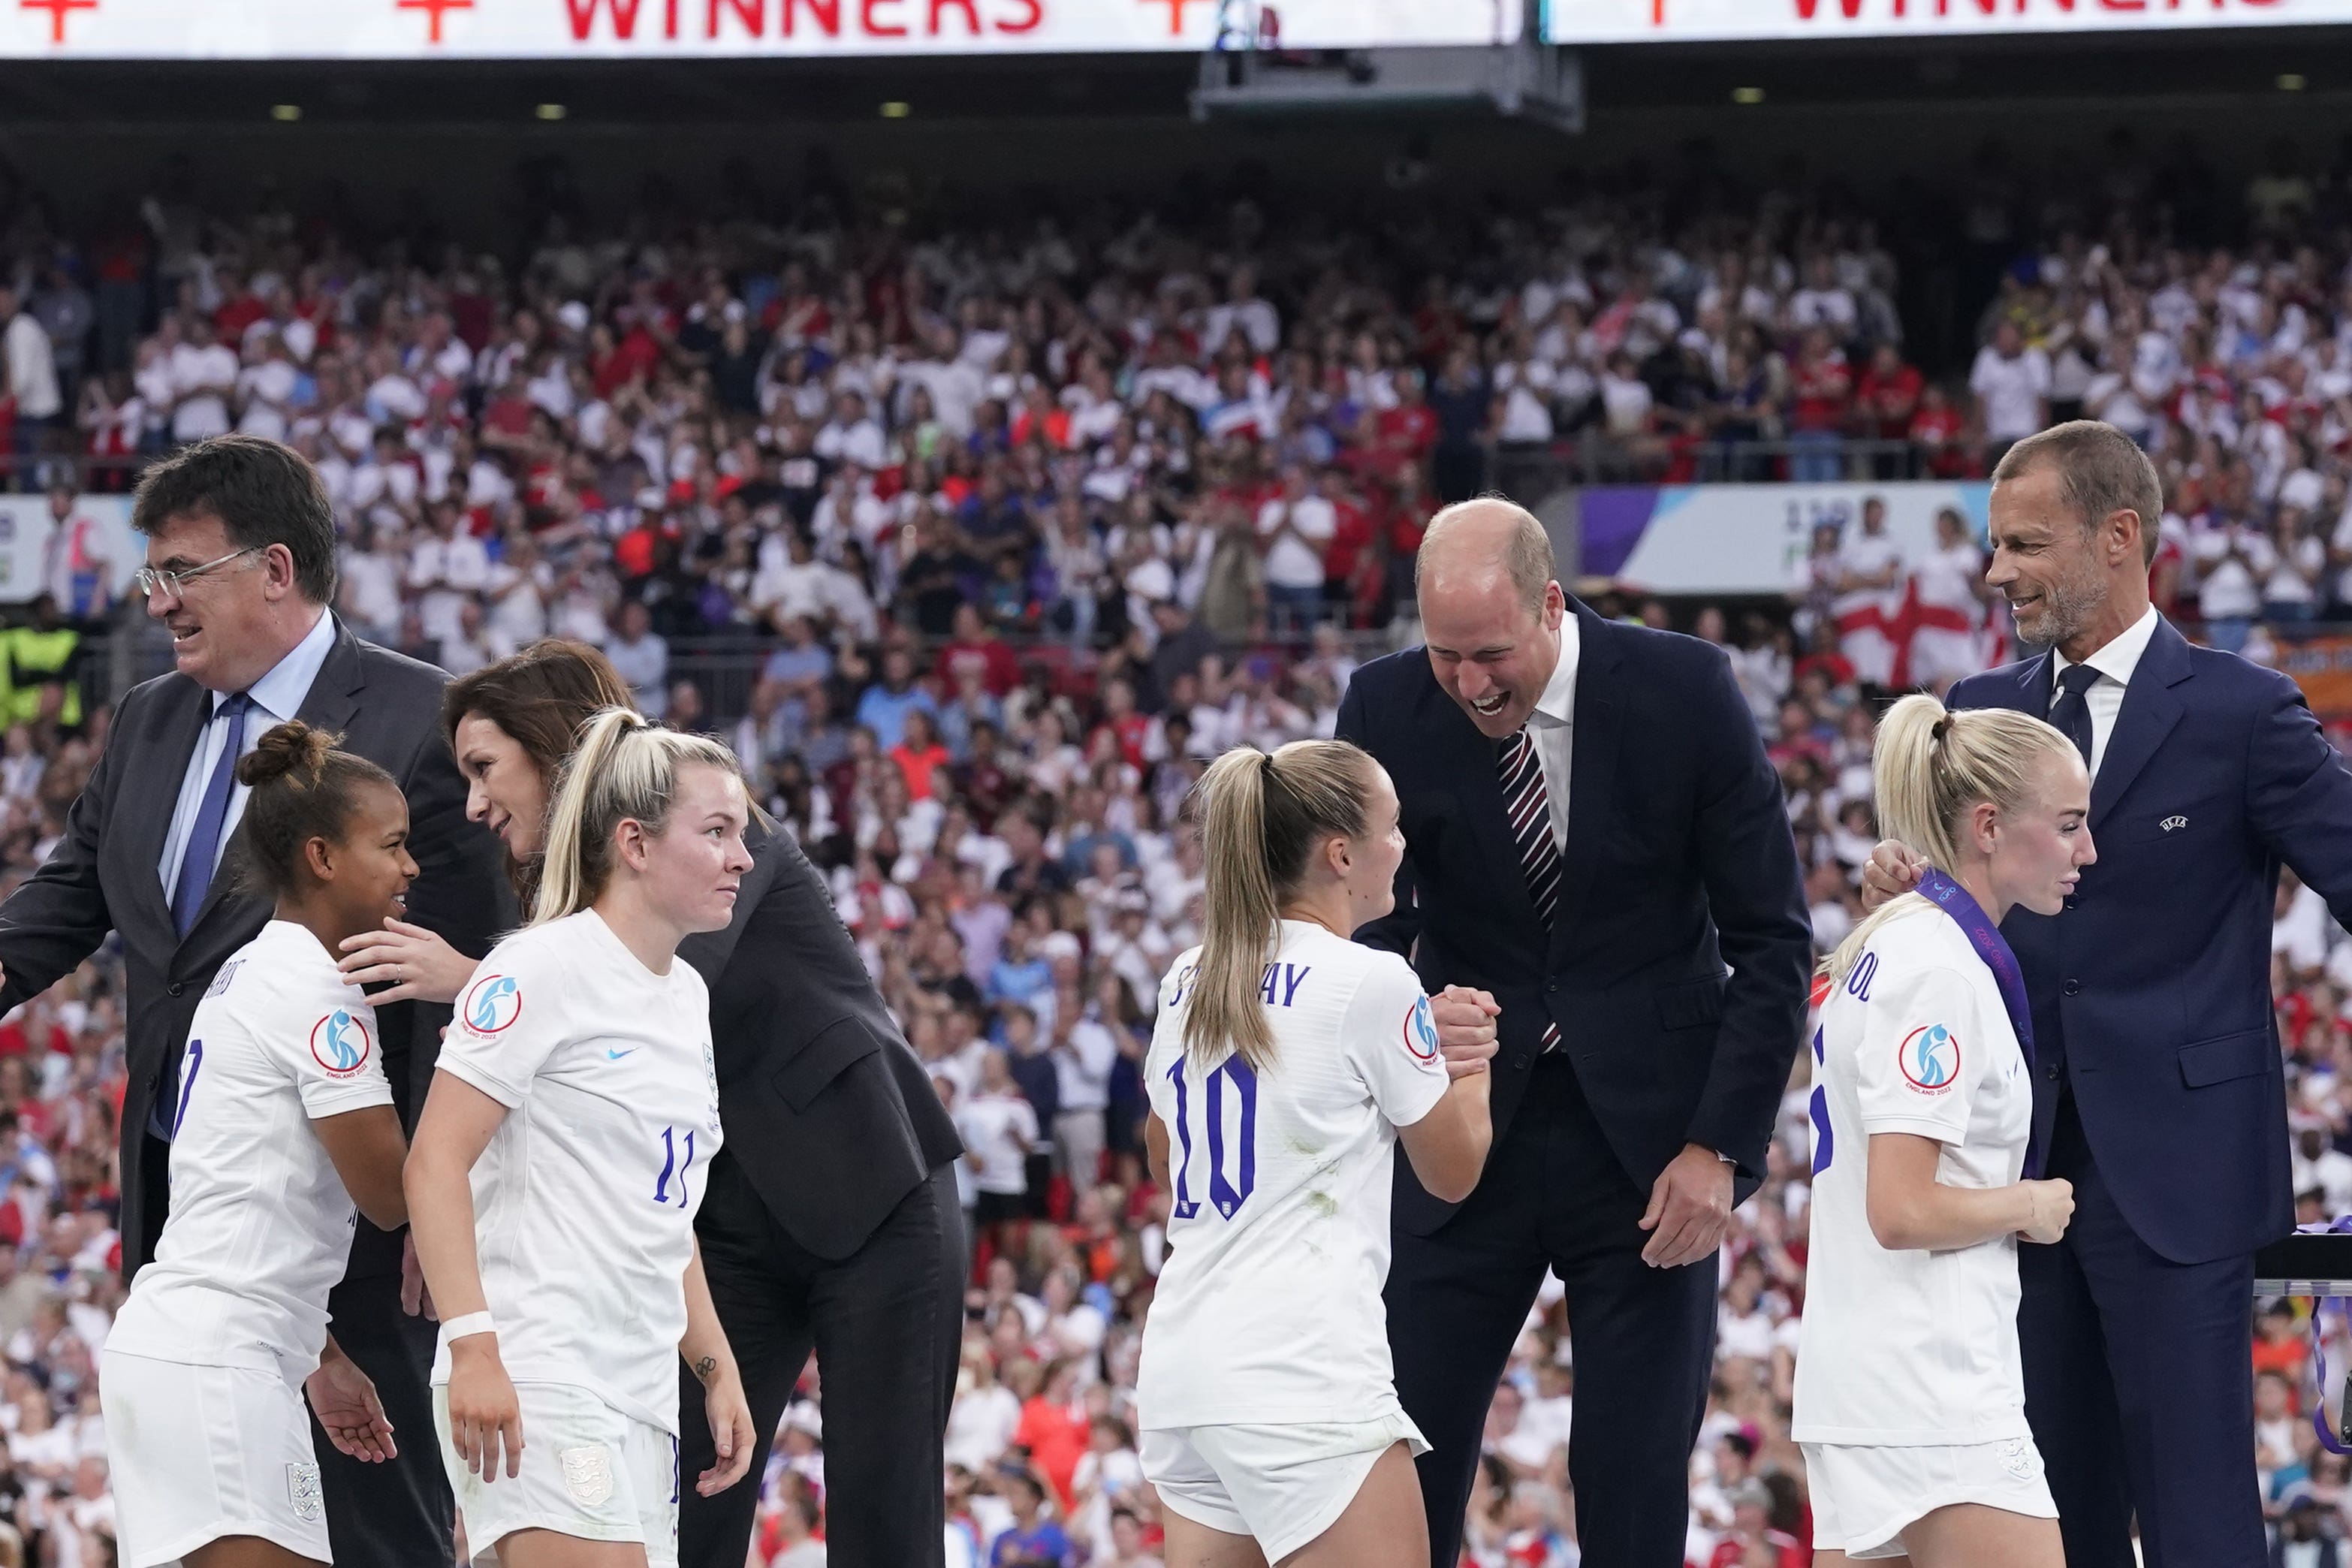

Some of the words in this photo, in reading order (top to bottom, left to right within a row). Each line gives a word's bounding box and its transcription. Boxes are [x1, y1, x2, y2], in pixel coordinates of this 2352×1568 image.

[2159, 816, 2188, 832] UEFA
[1905, 1081, 1935, 1096] ENGLAND
[1937, 1086, 1951, 1095] 2022
[1166, 1049, 1259, 1222] 10
[653, 1125, 694, 1208] 11
